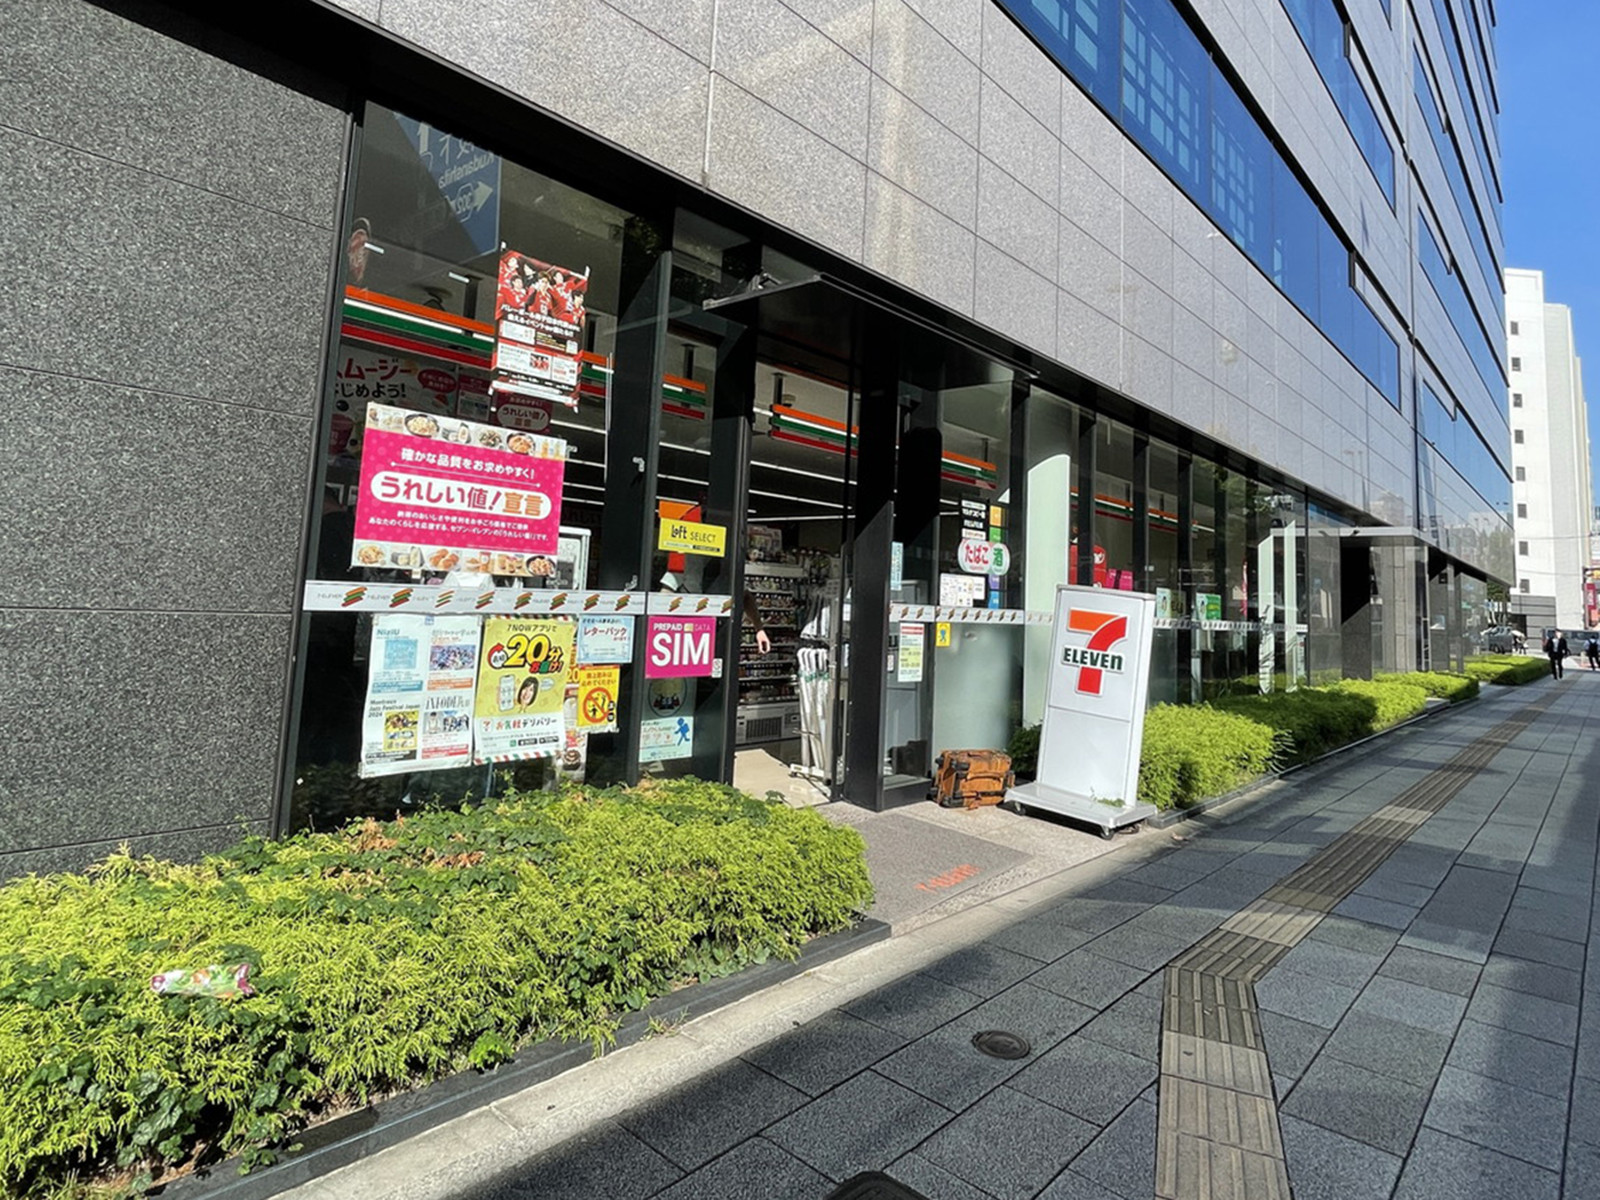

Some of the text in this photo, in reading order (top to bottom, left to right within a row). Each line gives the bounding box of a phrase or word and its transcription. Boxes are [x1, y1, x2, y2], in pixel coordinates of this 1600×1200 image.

[337, 357, 412, 381] ムージー
[401, 447, 535, 480] 確かな品質をお求めやすく!
[689, 531, 716, 543] SELECT
[964, 544, 989, 565] たばこ
[992, 547, 1004, 567] 酒
[584, 626, 627, 637] レターパック
[653, 622, 711, 632] PREPAID DATA
[651, 632, 710, 667] SIM
[1069, 609, 1127, 694] 7
